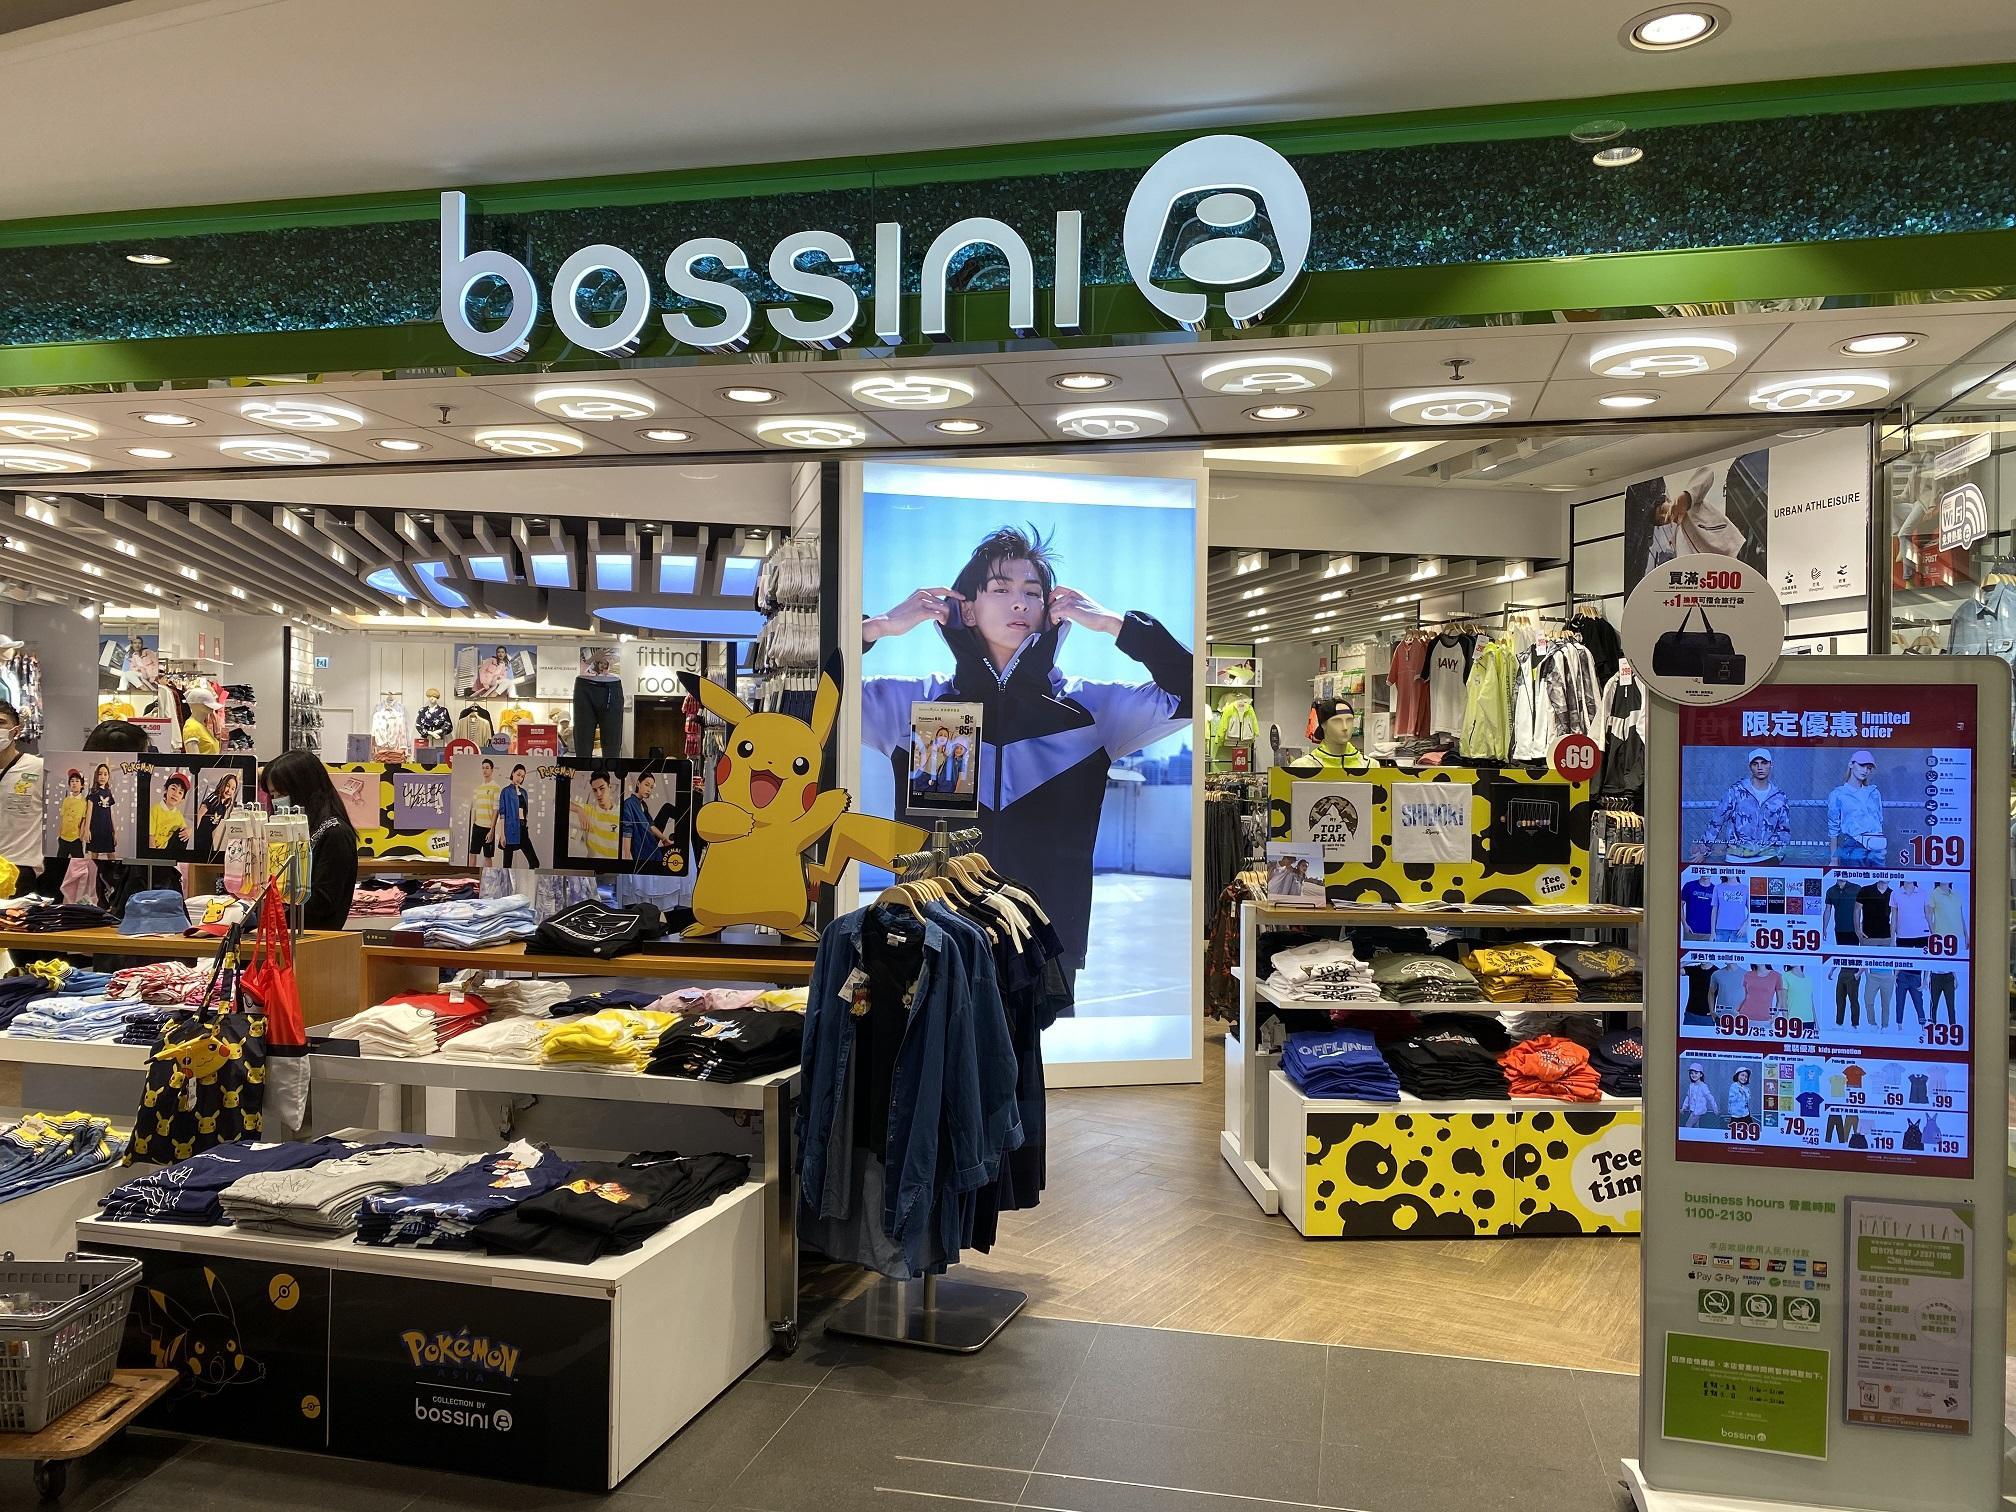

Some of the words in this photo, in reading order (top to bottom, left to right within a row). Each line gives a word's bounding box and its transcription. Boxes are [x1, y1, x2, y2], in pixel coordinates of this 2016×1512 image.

[440, 190, 1083, 358] bossini
[1774, 504, 1803, 518] URBAN
[1805, 492, 1860, 513] ATHLEISURE
[637, 646, 701, 672] fitting
[1742, 710, 1859, 738] 限定優惠
[1861, 711, 1911, 726] limited
[1861, 726, 1893, 738] offer
[1560, 745, 1594, 769] $69
[1321, 824, 1342, 832] TOP
[1312, 834, 1346, 842] PEAK
[1899, 835, 1966, 866] $169
[1719, 868, 1734, 876] print
[1872, 871, 1889, 879] solid
[1890, 872, 1904, 880] polo
[1542, 875, 1560, 886] Tee
[1542, 882, 1566, 894] time
[1750, 928, 1784, 950] $69
[1787, 930, 1820, 952] $59
[1923, 934, 1958, 956] $69
[1864, 959, 1893, 968] selected
[1919, 1024, 1964, 1046] $139
[1298, 1042, 1373, 1056] OFFLINE
[1818, 1046, 1830, 1054] kids
[1831, 1046, 1862, 1056] promotion
[1846, 1090, 1866, 1104] $59
[1884, 1092, 1904, 1106] $69
[1932, 1095, 1952, 1108] $99
[1724, 1122, 1760, 1141] $139
[1870, 1137, 1894, 1150] $119
[1933, 1140, 1959, 1154] $139
[1592, 1149, 1641, 1176] Tee
[1588, 1174, 1641, 1203] tim
[1684, 1192, 1743, 1206] business
[1746, 1196, 1785, 1210] hours
[1684, 1206, 1752, 1222] 1100-2130
[1859, 1219, 1912, 1238] HAPPY
[1921, 1224, 1964, 1242] TEAM
[1696, 1271, 1712, 1282] Pay
[1724, 1274, 1740, 1284] Pay
[401, 1326, 520, 1378] Pokémon
[432, 1396, 474, 1407] COLLECTION
[416, 1398, 488, 1429] bossini
[1722, 1428, 1756, 1441] bossini
